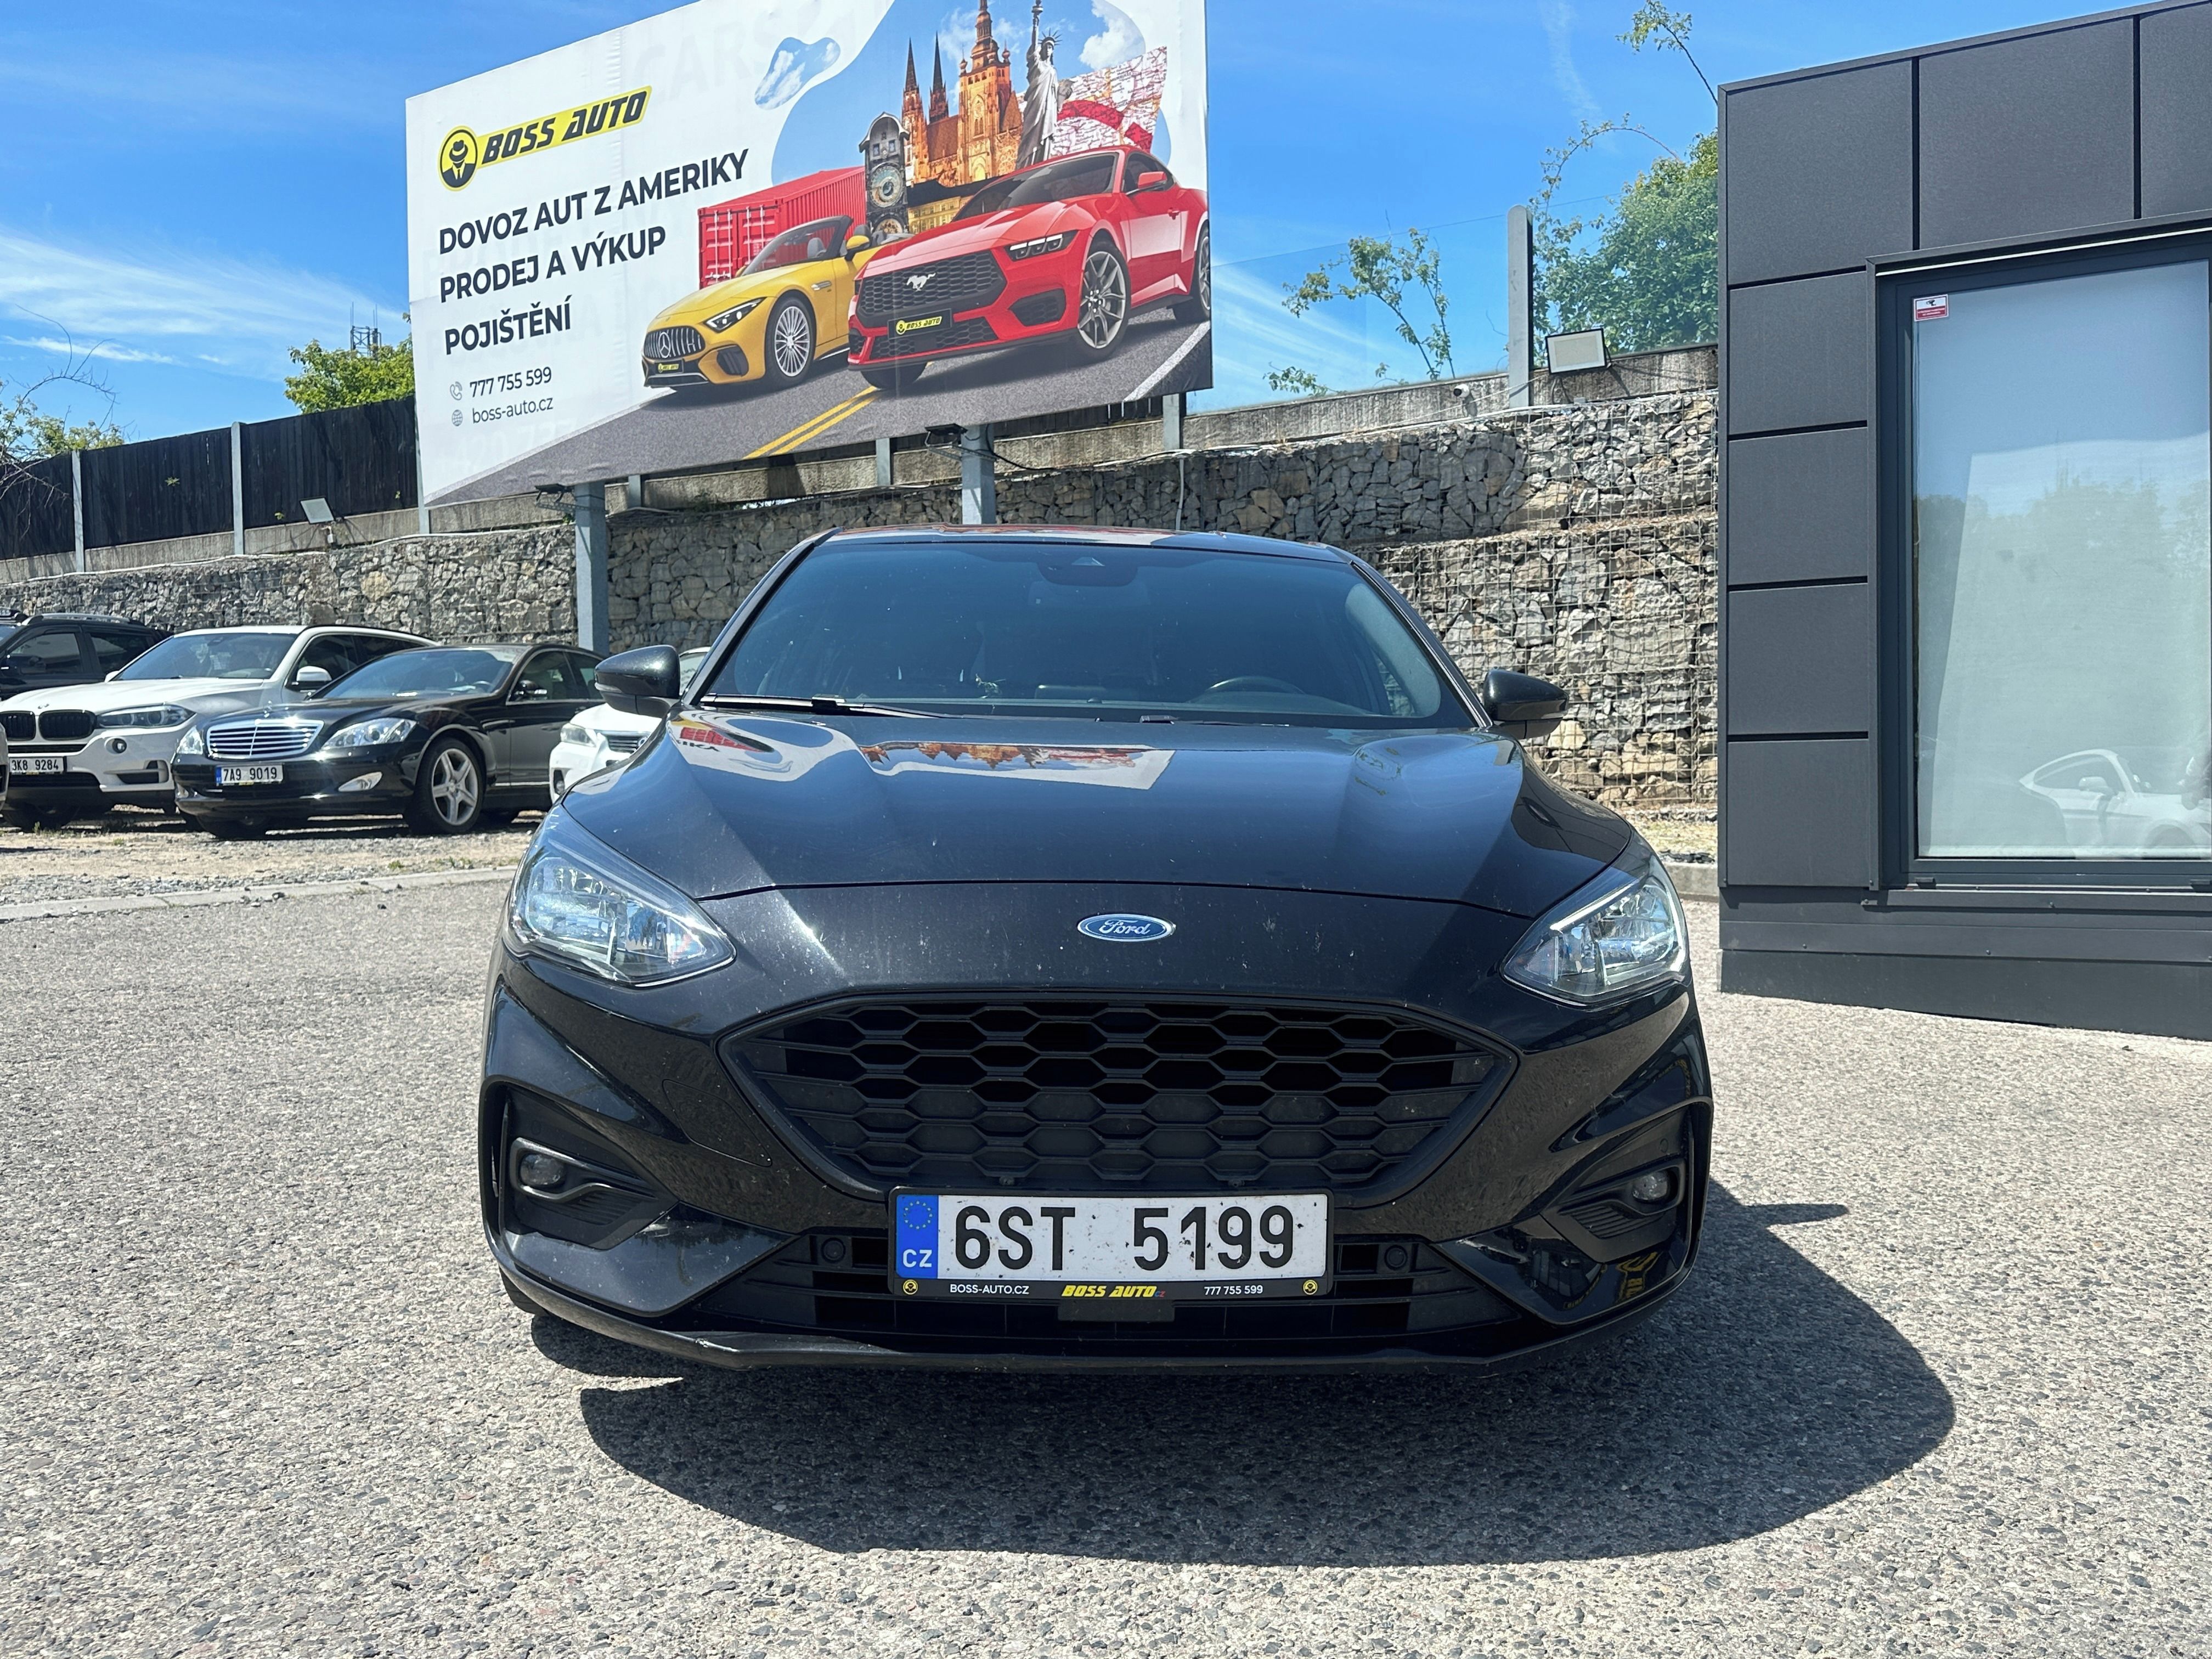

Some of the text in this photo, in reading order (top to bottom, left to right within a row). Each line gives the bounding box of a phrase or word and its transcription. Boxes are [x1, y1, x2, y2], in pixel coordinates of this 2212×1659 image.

[482, 91, 647, 165] BOSS AUTO
[439, 149, 749, 255] DOVOZ AUT Z AMERIKY
[441, 226, 666, 303] PRODEJ A VÝKUP
[445, 295, 572, 355] POJIŠTĚNÍ
[470, 367, 552, 398] 777 755 599
[472, 398, 553, 424] boss-auto.cz
[12, 759, 59, 770] 3K8 9284
[224, 767, 276, 781] 7A9 9019
[1099, 919, 1151, 934] Ford
[955, 1205, 1294, 1271] 6ST 5199
[902, 1249, 933, 1268] CZ
[950, 1284, 1030, 1295] BOSS-AUTO.CZ
[1062, 1285, 1107, 1297] BOSS
[1204, 1285, 1263, 1295] 777 755 599
